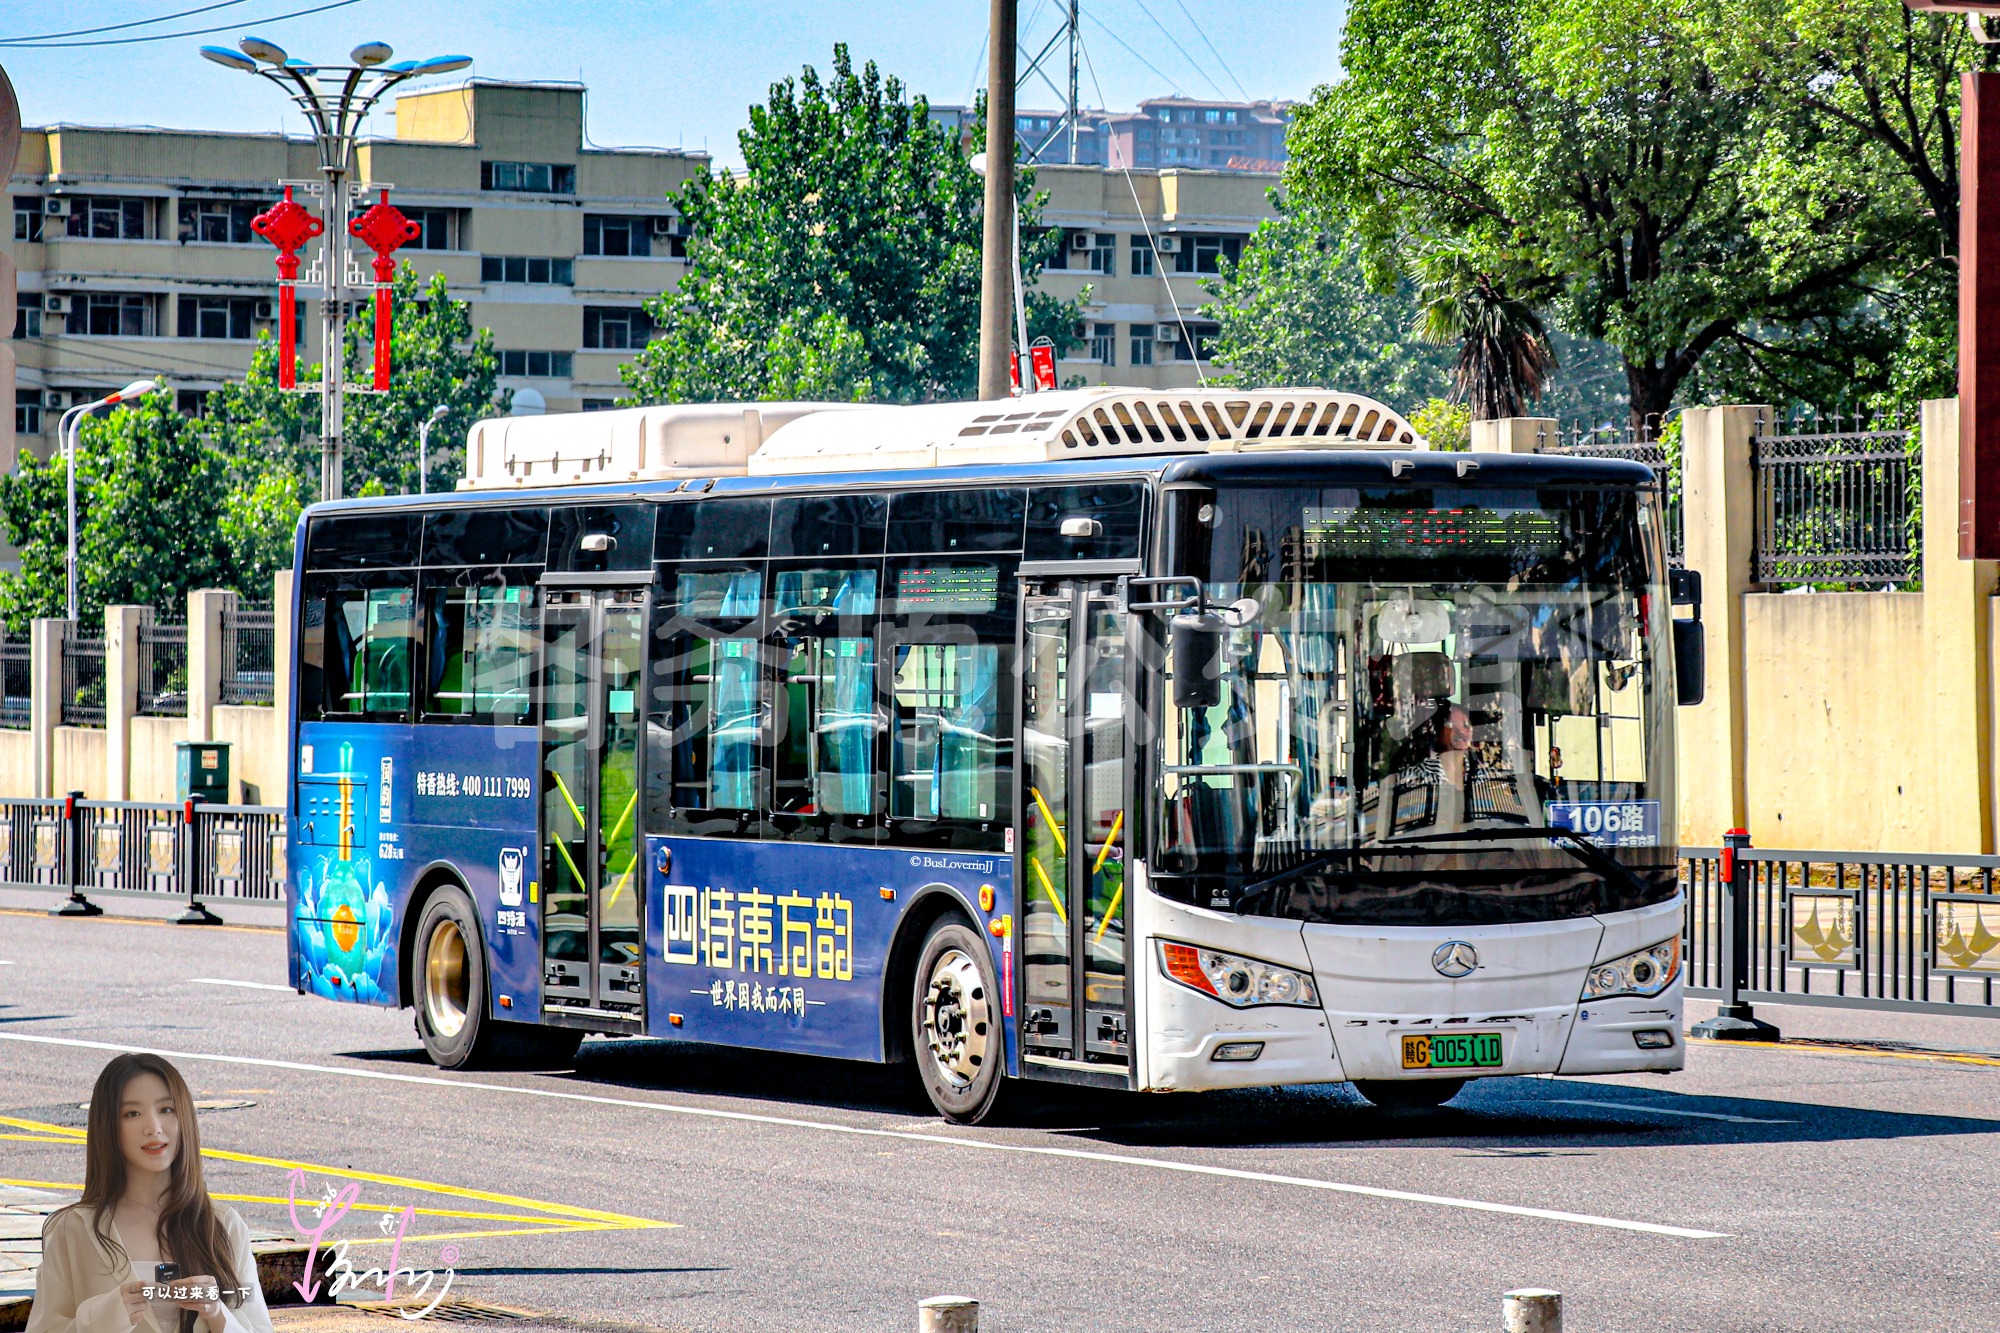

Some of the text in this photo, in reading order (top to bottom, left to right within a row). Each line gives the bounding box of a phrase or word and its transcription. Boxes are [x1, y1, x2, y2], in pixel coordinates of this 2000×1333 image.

[417, 772, 531, 798] 特香热线: 400 111 7999
[1568, 804, 1644, 832] 106路
